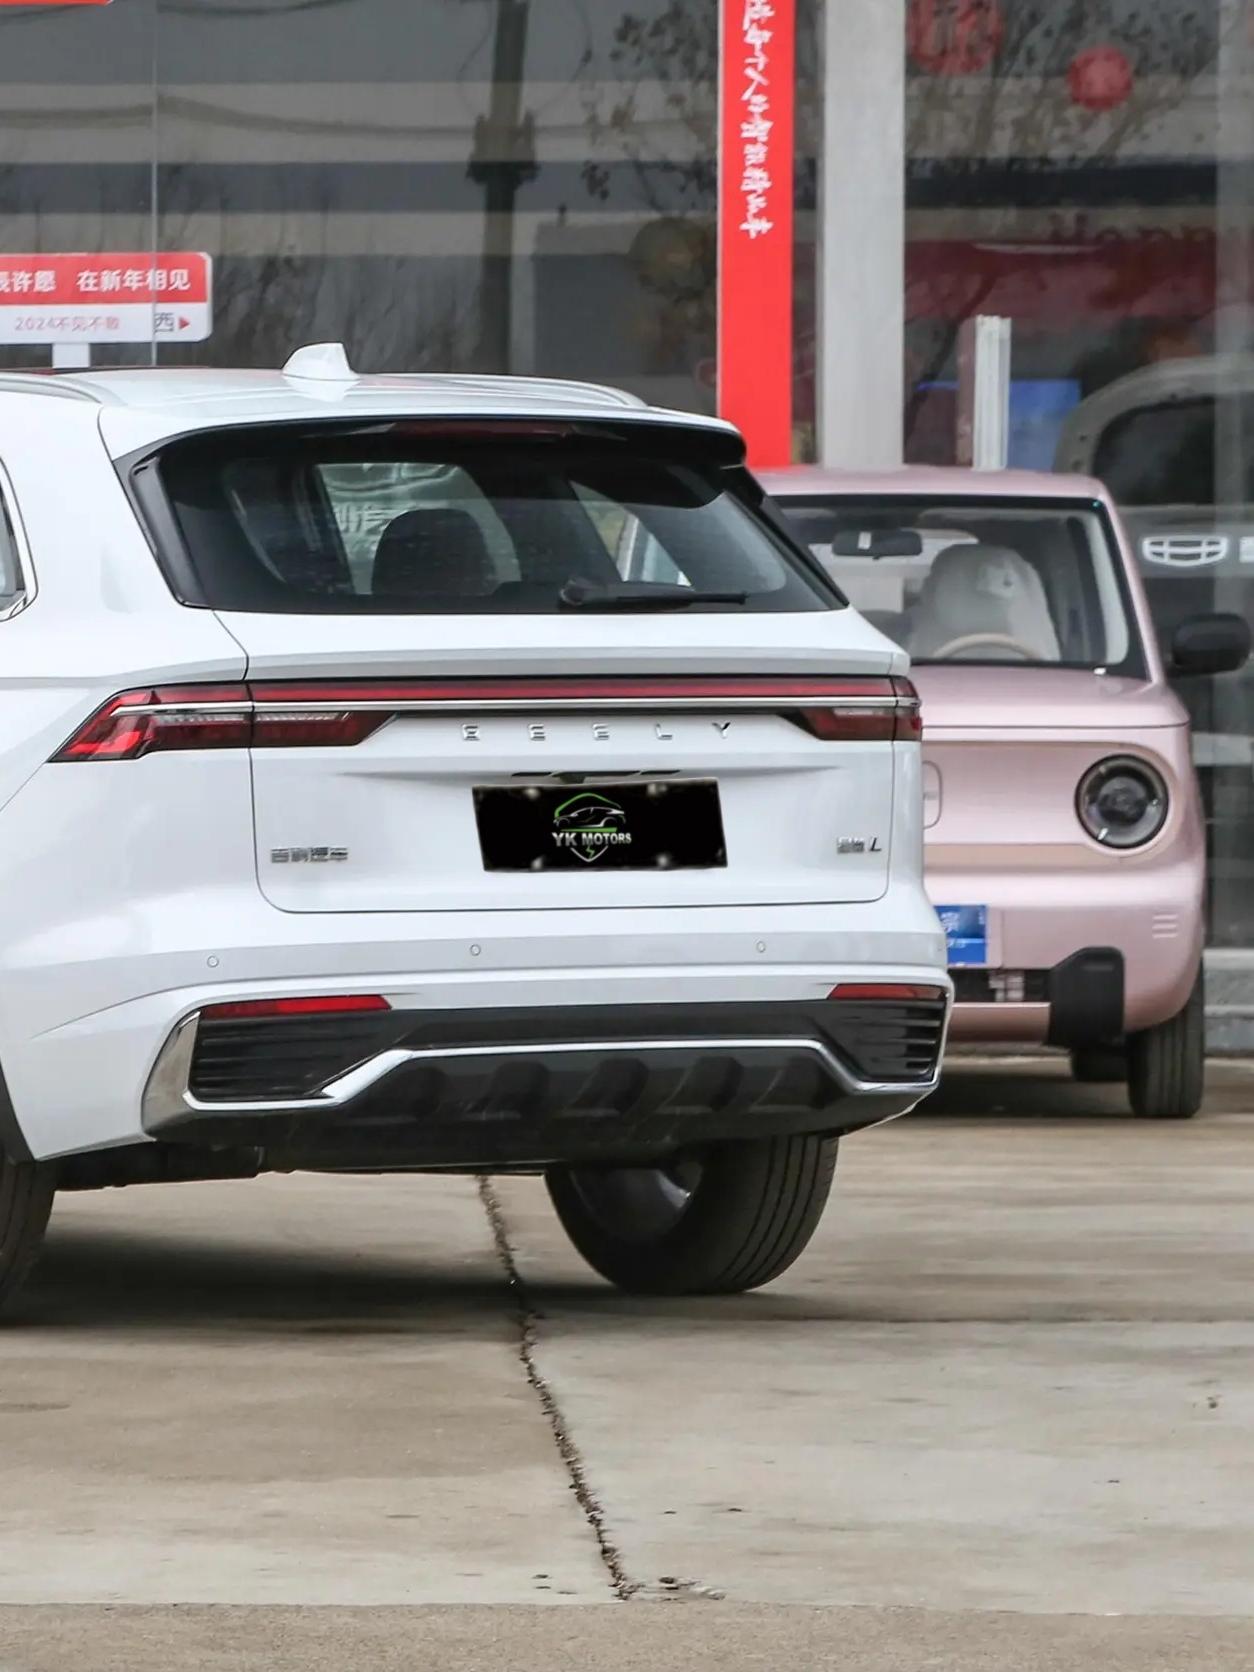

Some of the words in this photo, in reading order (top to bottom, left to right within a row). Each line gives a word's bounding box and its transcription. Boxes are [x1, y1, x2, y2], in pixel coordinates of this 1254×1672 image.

[77, 268, 191, 292] 在新年相见
[153, 312, 175, 333] 西
[462, 722, 731, 740] GEELY
